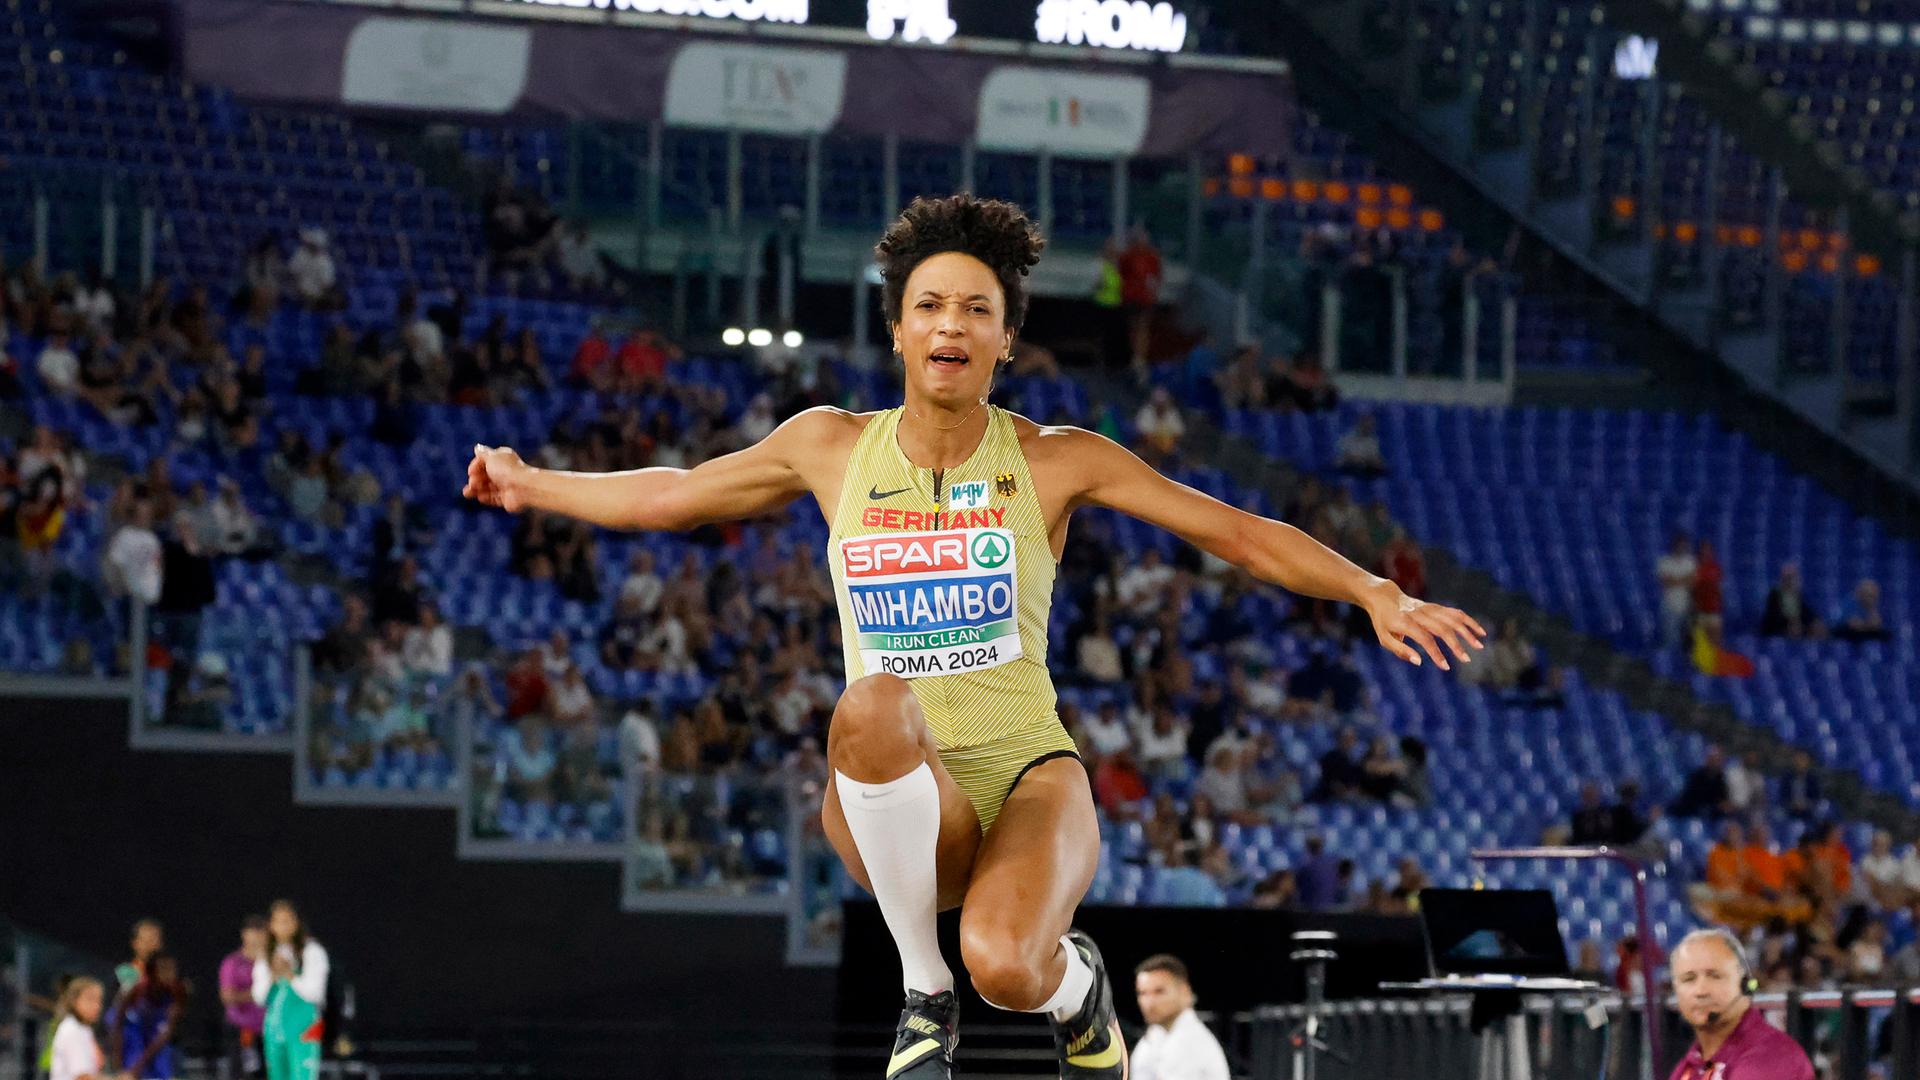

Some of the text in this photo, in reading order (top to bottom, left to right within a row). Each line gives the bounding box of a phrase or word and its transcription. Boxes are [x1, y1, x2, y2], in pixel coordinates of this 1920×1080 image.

[862, 506, 1006, 530] GERMANY
[846, 538, 965, 573] SPAR
[850, 580, 1013, 627] MIHAMBO
[893, 635, 925, 649] RUN
[881, 645, 999, 674] ROMA 2024
[904, 1014, 942, 1036] NIKE
[1066, 1026, 1096, 1056] NIKE
